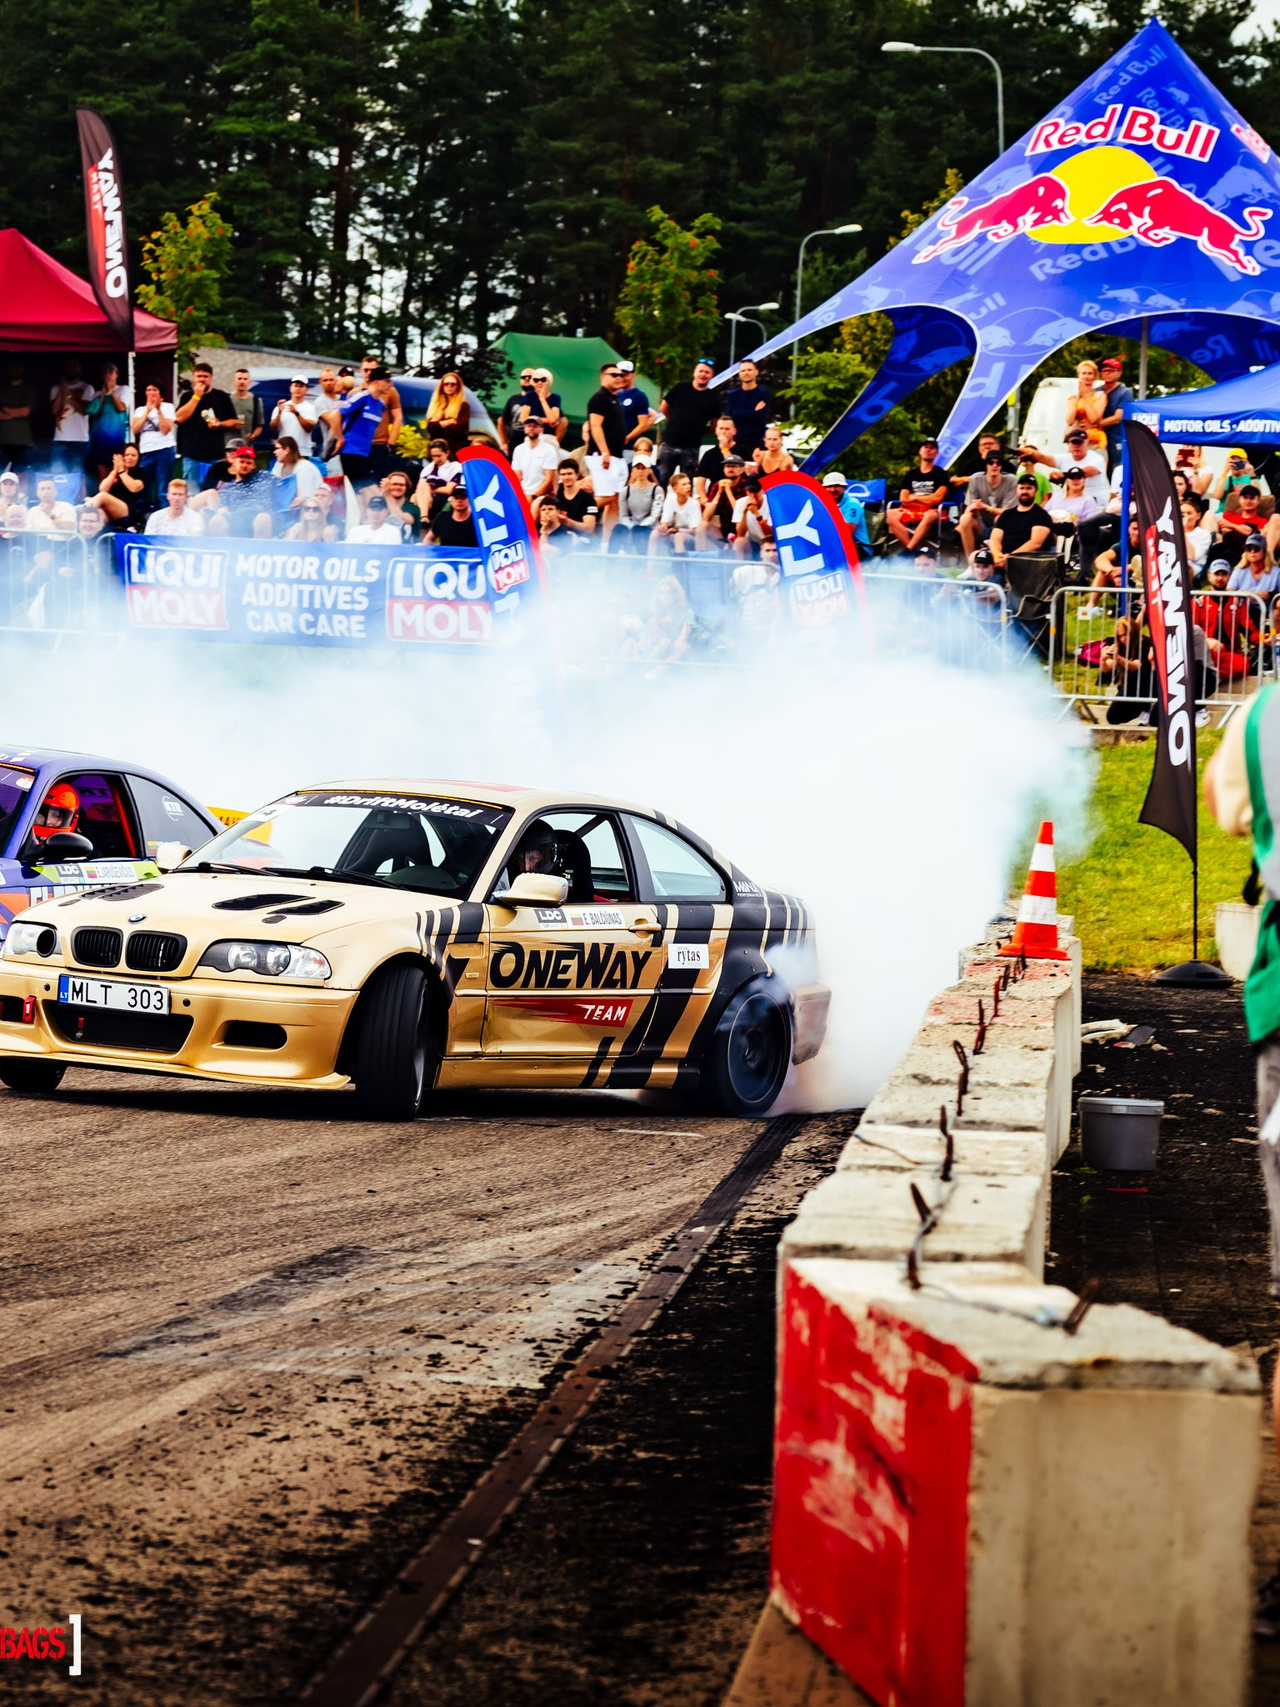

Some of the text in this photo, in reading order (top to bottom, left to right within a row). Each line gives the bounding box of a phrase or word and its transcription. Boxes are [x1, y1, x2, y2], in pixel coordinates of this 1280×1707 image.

[1025, 104, 1123, 156] Red
[1118, 106, 1220, 162] Bull
[1164, 419, 1204, 433] MOTOR
[1205, 419, 1231, 433] OILS
[128, 549, 221, 590] LIQUI
[236, 555, 381, 583] MOTOR OILS
[394, 561, 486, 600] LIQU
[129, 589, 224, 627] MOLY
[241, 582, 370, 611] ADDITIVES
[246, 610, 367, 639] CAR CARE
[394, 602, 494, 640] MOLY
[323, 795, 482, 818] #DriftMolétal
[489, 941, 653, 989] ONEWAY
[677, 949, 701, 965] rytas
[71, 980, 164, 1011] MLT 303
[577, 1004, 628, 1022] TEAM
